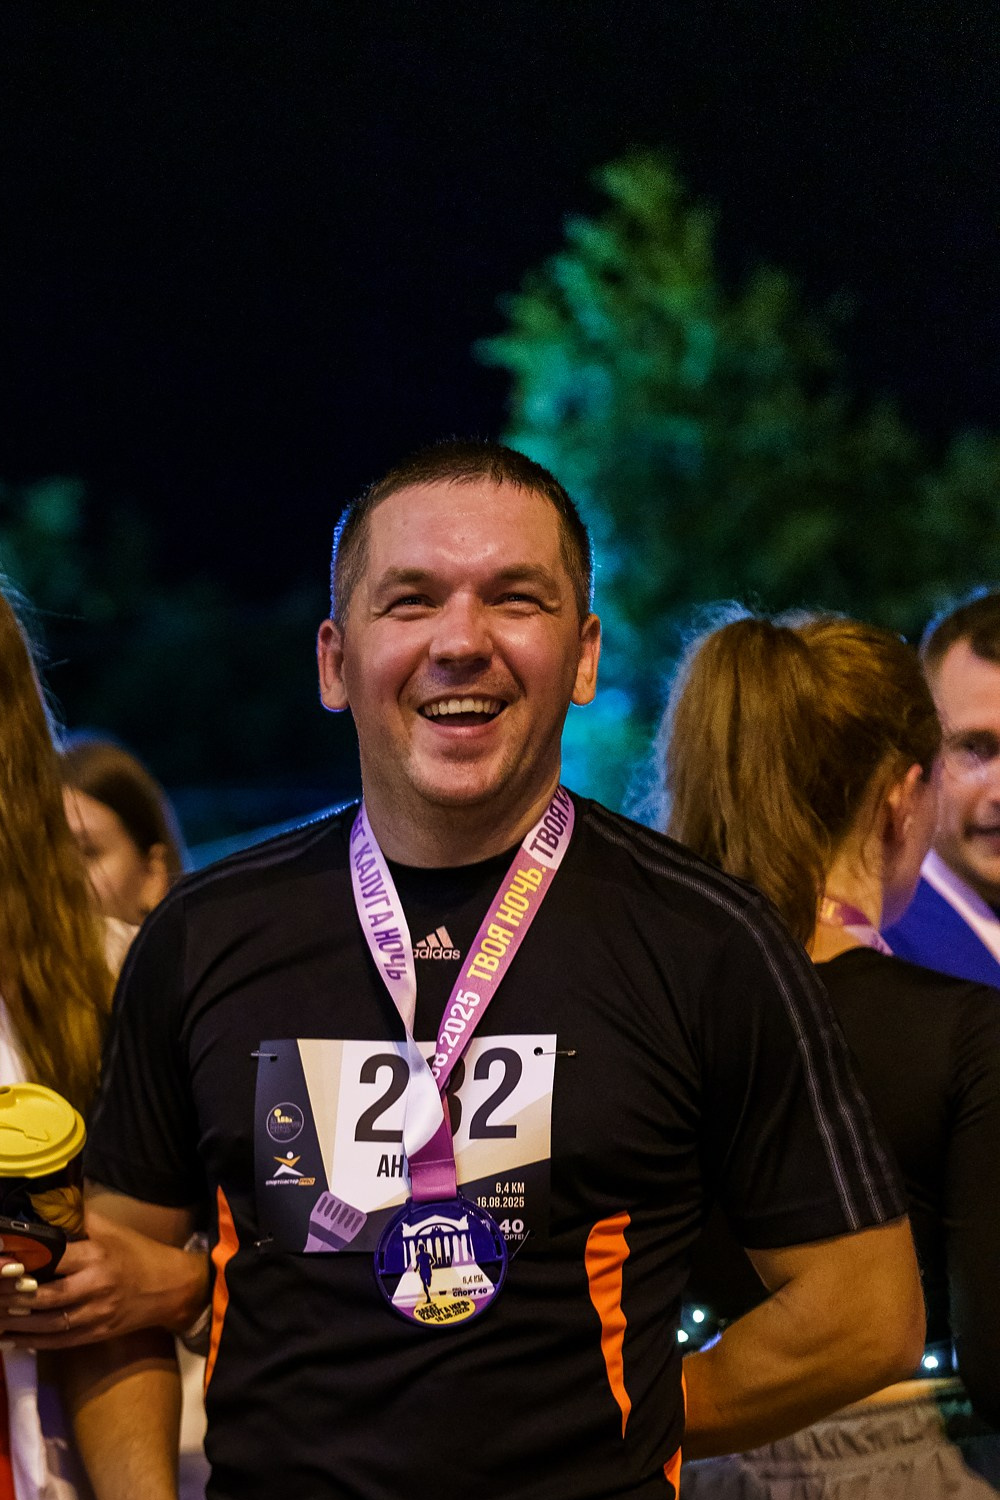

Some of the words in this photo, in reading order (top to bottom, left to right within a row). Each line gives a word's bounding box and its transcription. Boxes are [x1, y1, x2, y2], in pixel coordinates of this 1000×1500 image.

[467, 922, 514, 981] ТВОЯ
[496, 866, 546, 927] НОЧЬ.
[529, 801, 569, 860] ТВОЯ
[412, 946, 461, 960] adidas
[495, 1182, 509, 1195] 6,4
[477, 1196, 525, 1208] 16.08.2025
[498, 1218, 525, 1234] 40
